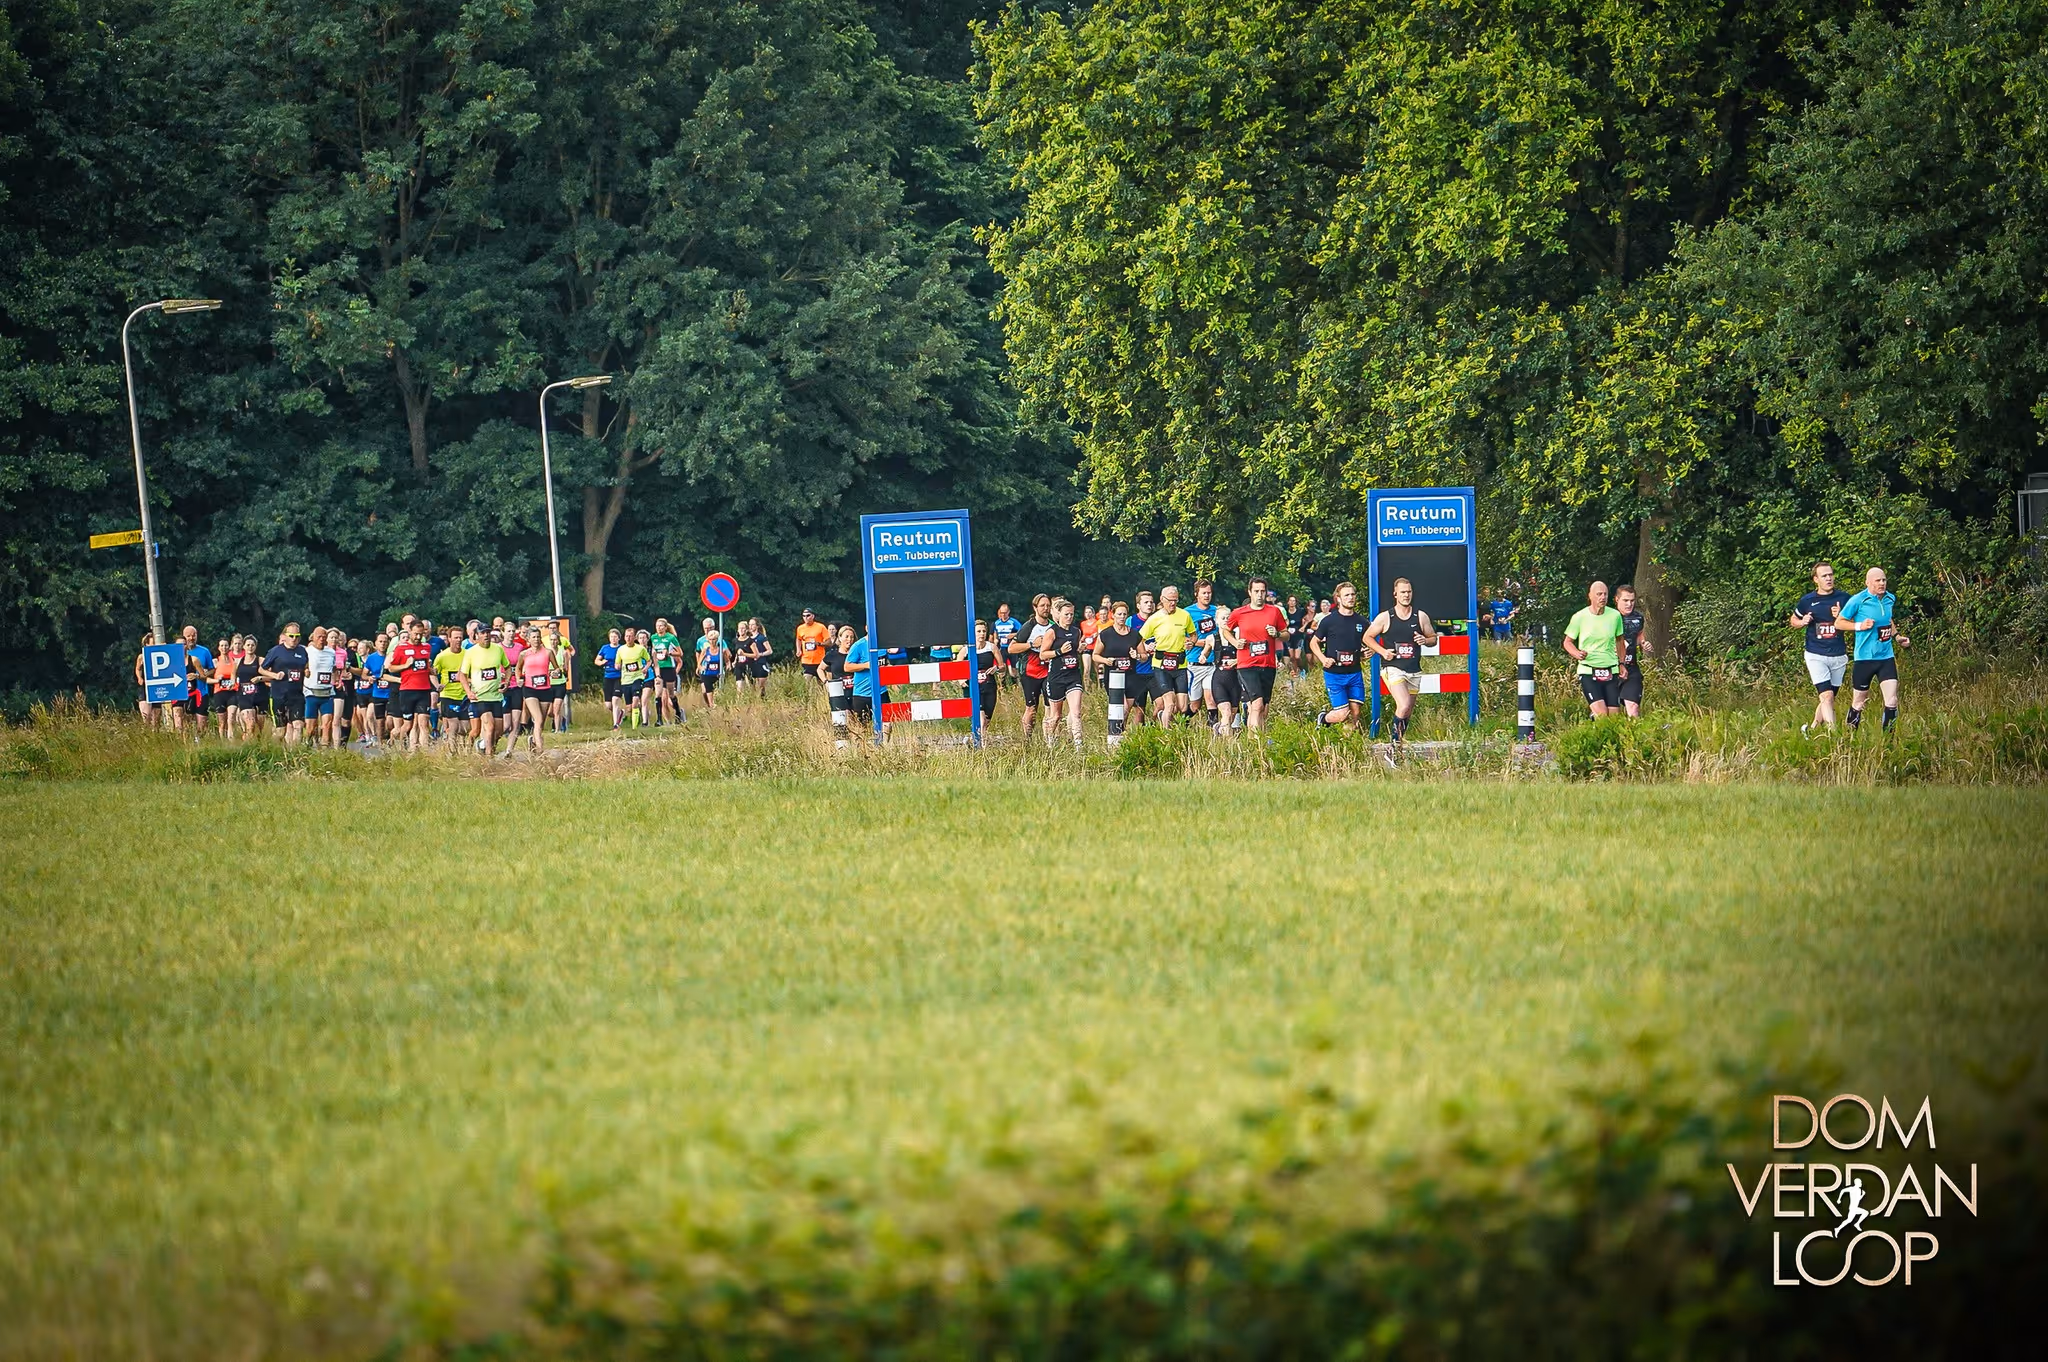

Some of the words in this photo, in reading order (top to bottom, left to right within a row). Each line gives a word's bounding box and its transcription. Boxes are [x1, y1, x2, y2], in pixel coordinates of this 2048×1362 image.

[1386, 506, 1456, 521] Reutum
[1382, 527, 1406, 538] gem.
[1409, 525, 1461, 536] Tubbergen
[880, 531, 952, 547] Reutum
[877, 553, 902, 564] gem.
[904, 550, 958, 561] Tubbergen
[1819, 625, 1835, 634] 718
[1398, 646, 1413, 654] 692
[151, 652, 170, 677] P
[1163, 659, 1177, 667] 653
